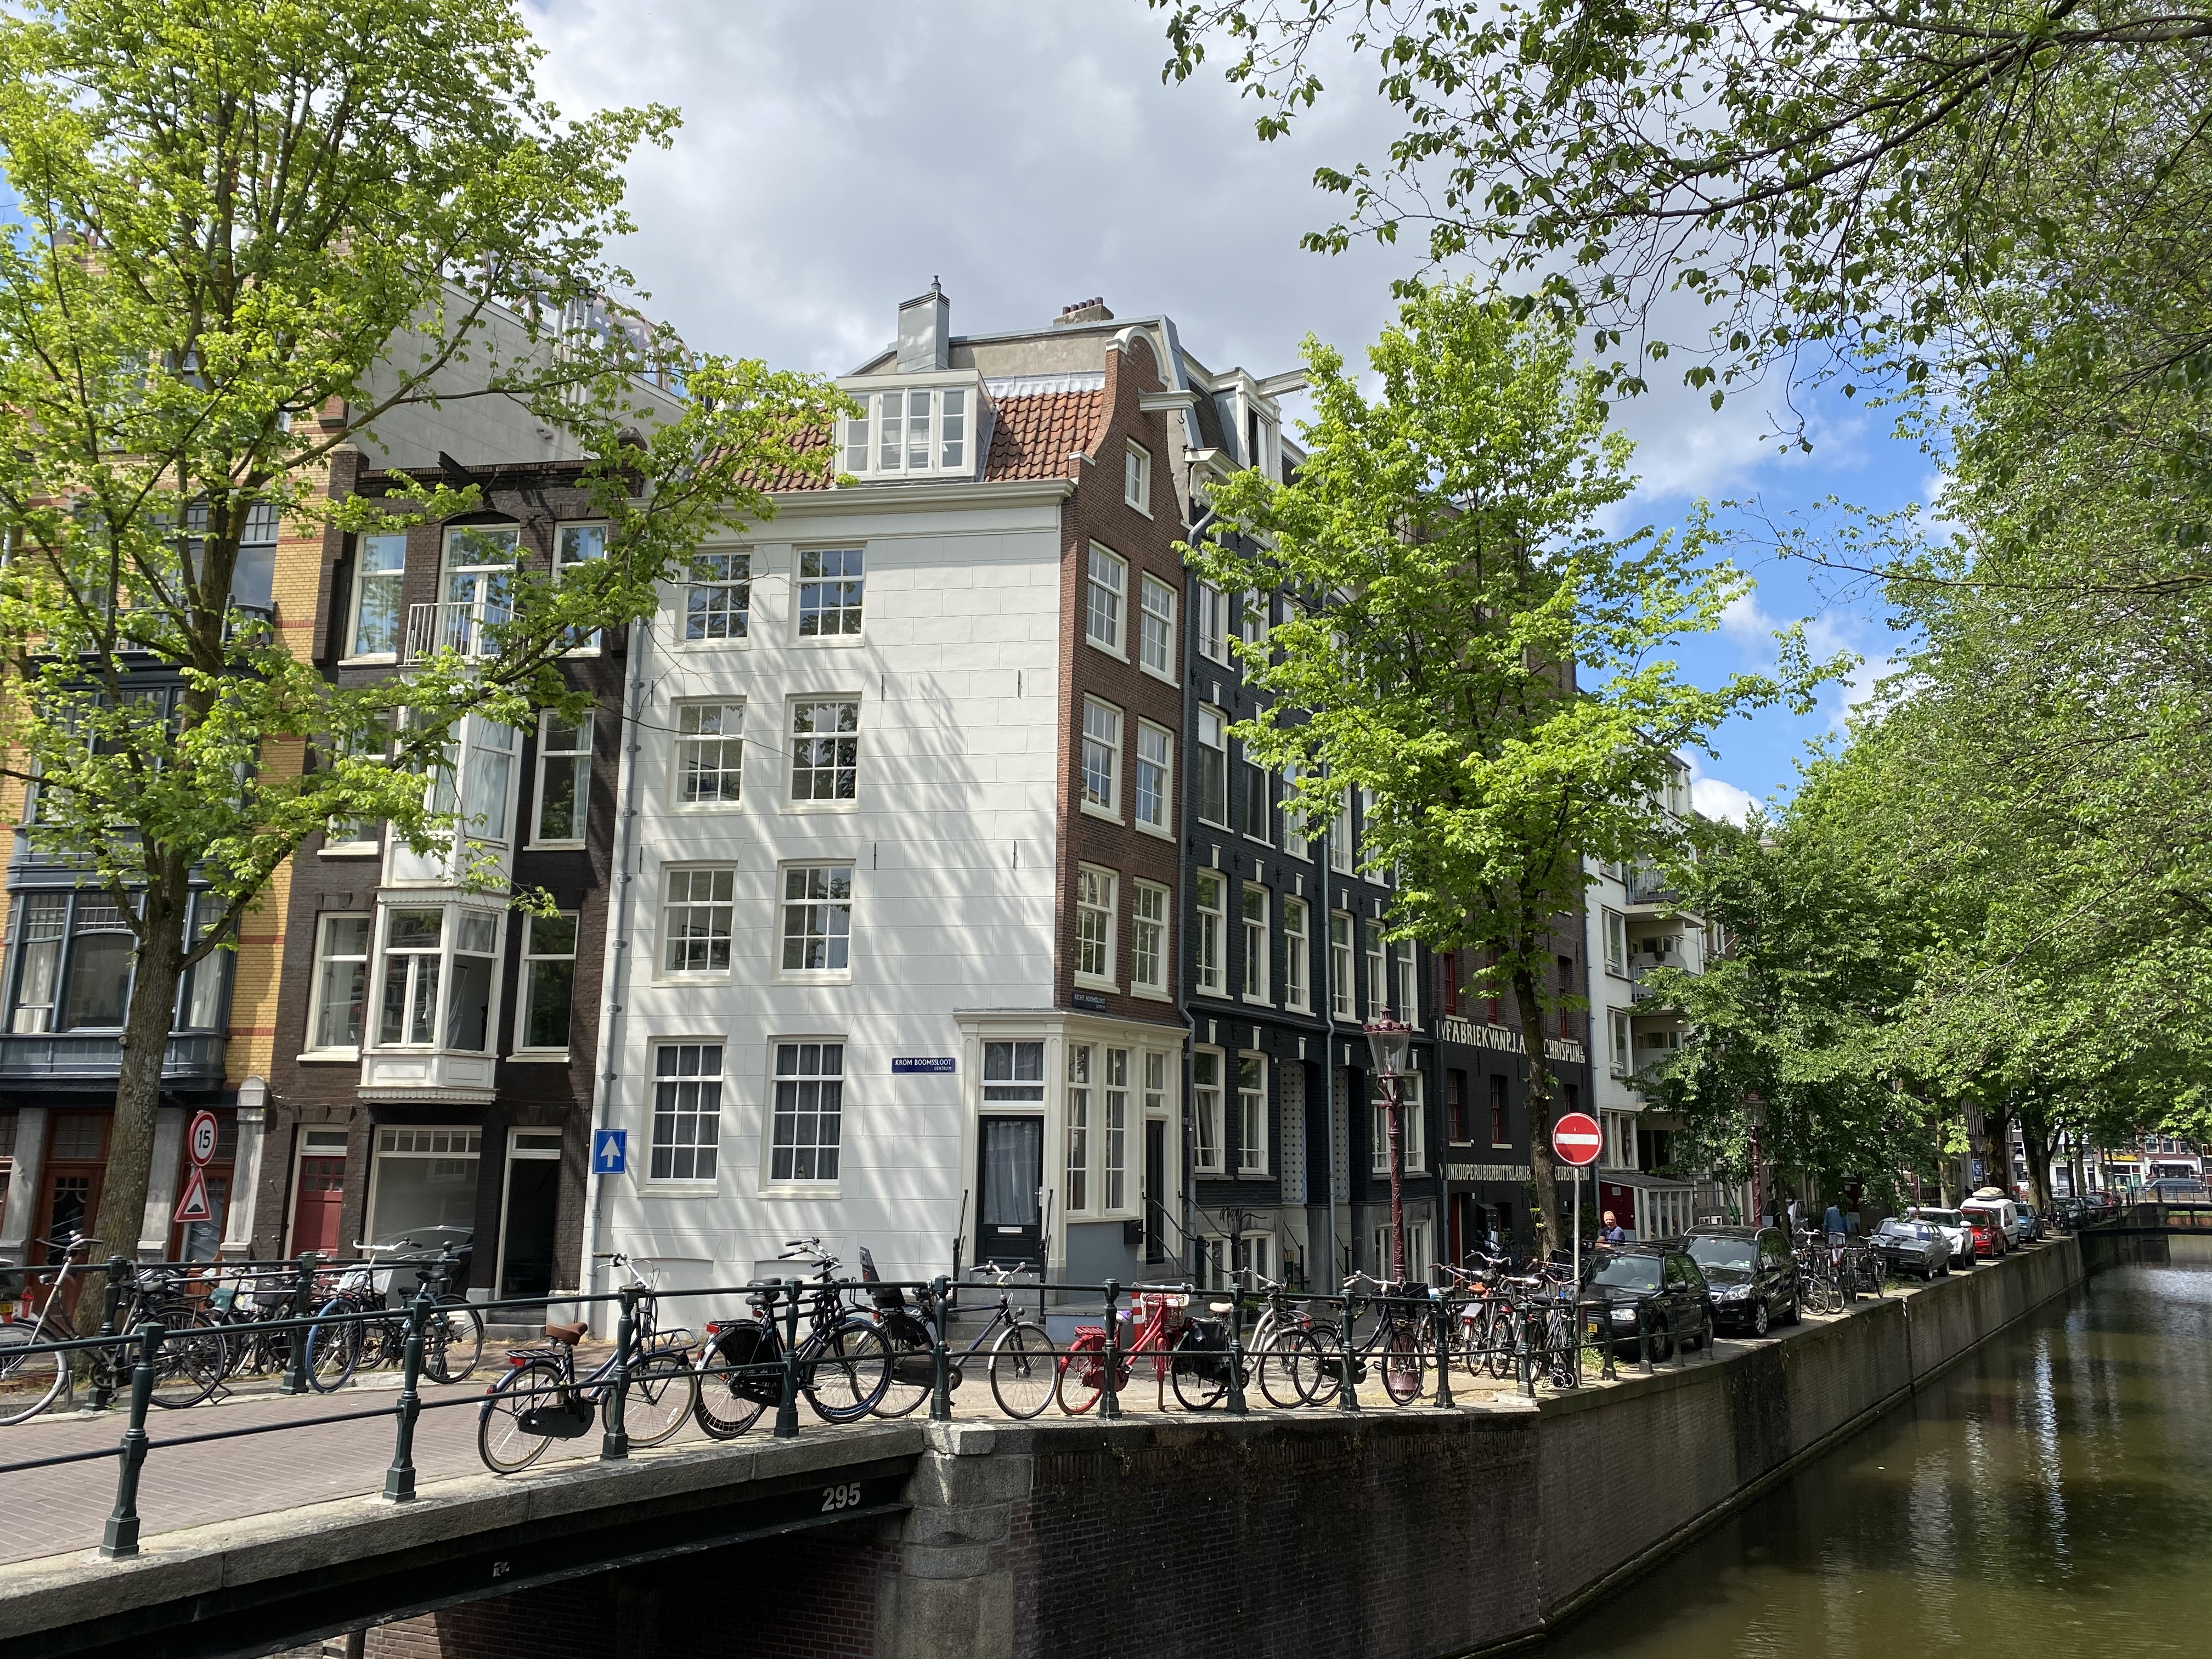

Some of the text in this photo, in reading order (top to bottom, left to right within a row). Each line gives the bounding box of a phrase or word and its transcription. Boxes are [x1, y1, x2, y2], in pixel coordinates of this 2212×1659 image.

[1446, 1020, 1489, 1048] FABRIEK
[1544, 1039, 1580, 1063] CHRISPIJN
[198, 1130, 211, 1149] 15
[821, 1482, 861, 1512] 295
